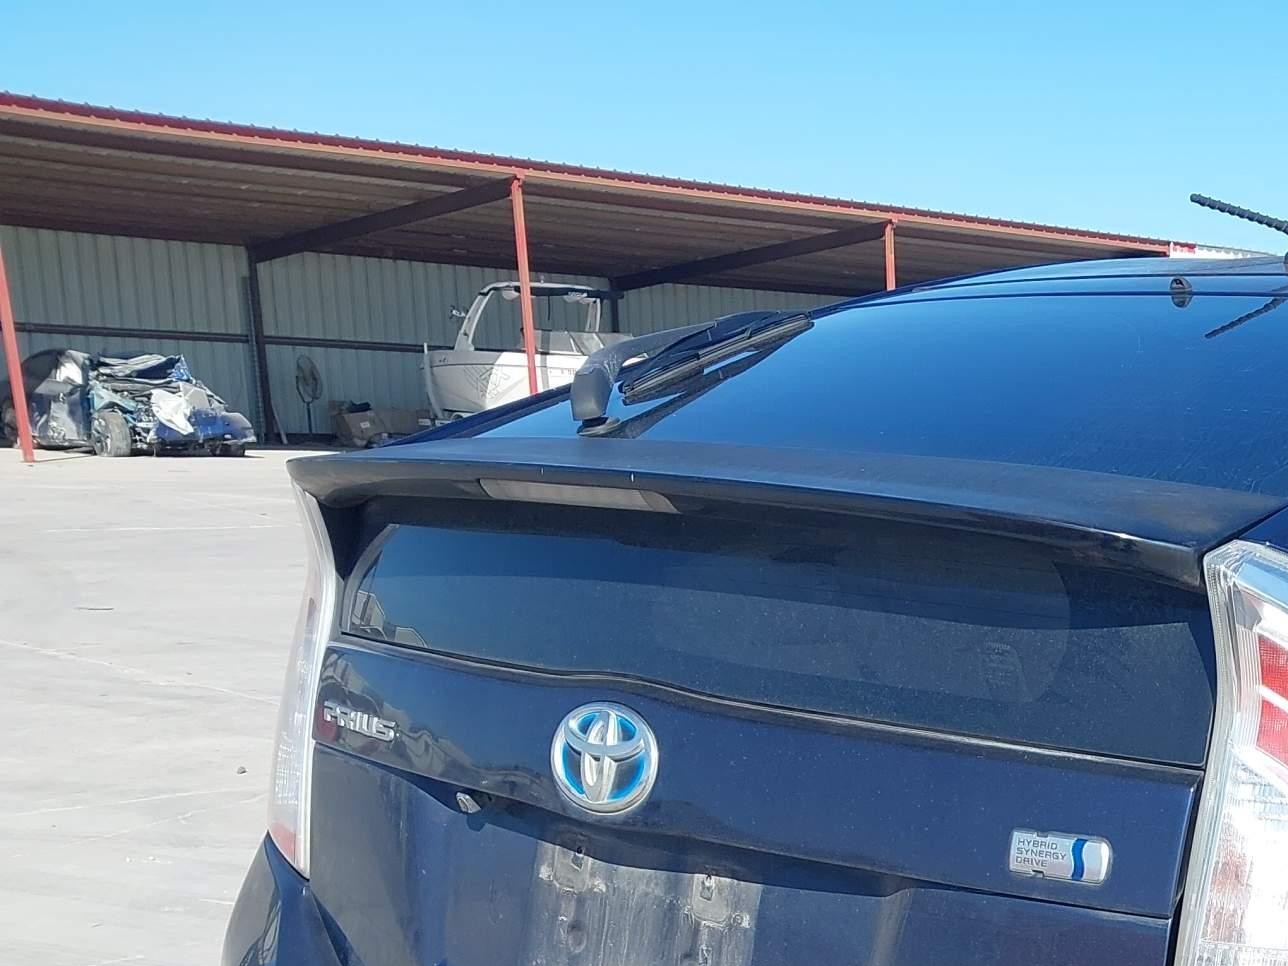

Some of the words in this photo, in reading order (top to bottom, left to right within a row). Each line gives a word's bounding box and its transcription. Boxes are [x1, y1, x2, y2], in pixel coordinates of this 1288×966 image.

[323, 701, 396, 741] PRIUS
[1017, 837, 1058, 850] HYBRID
[1016, 847, 1067, 860] SYNERGY
[1015, 856, 1048, 868] DRIVE
